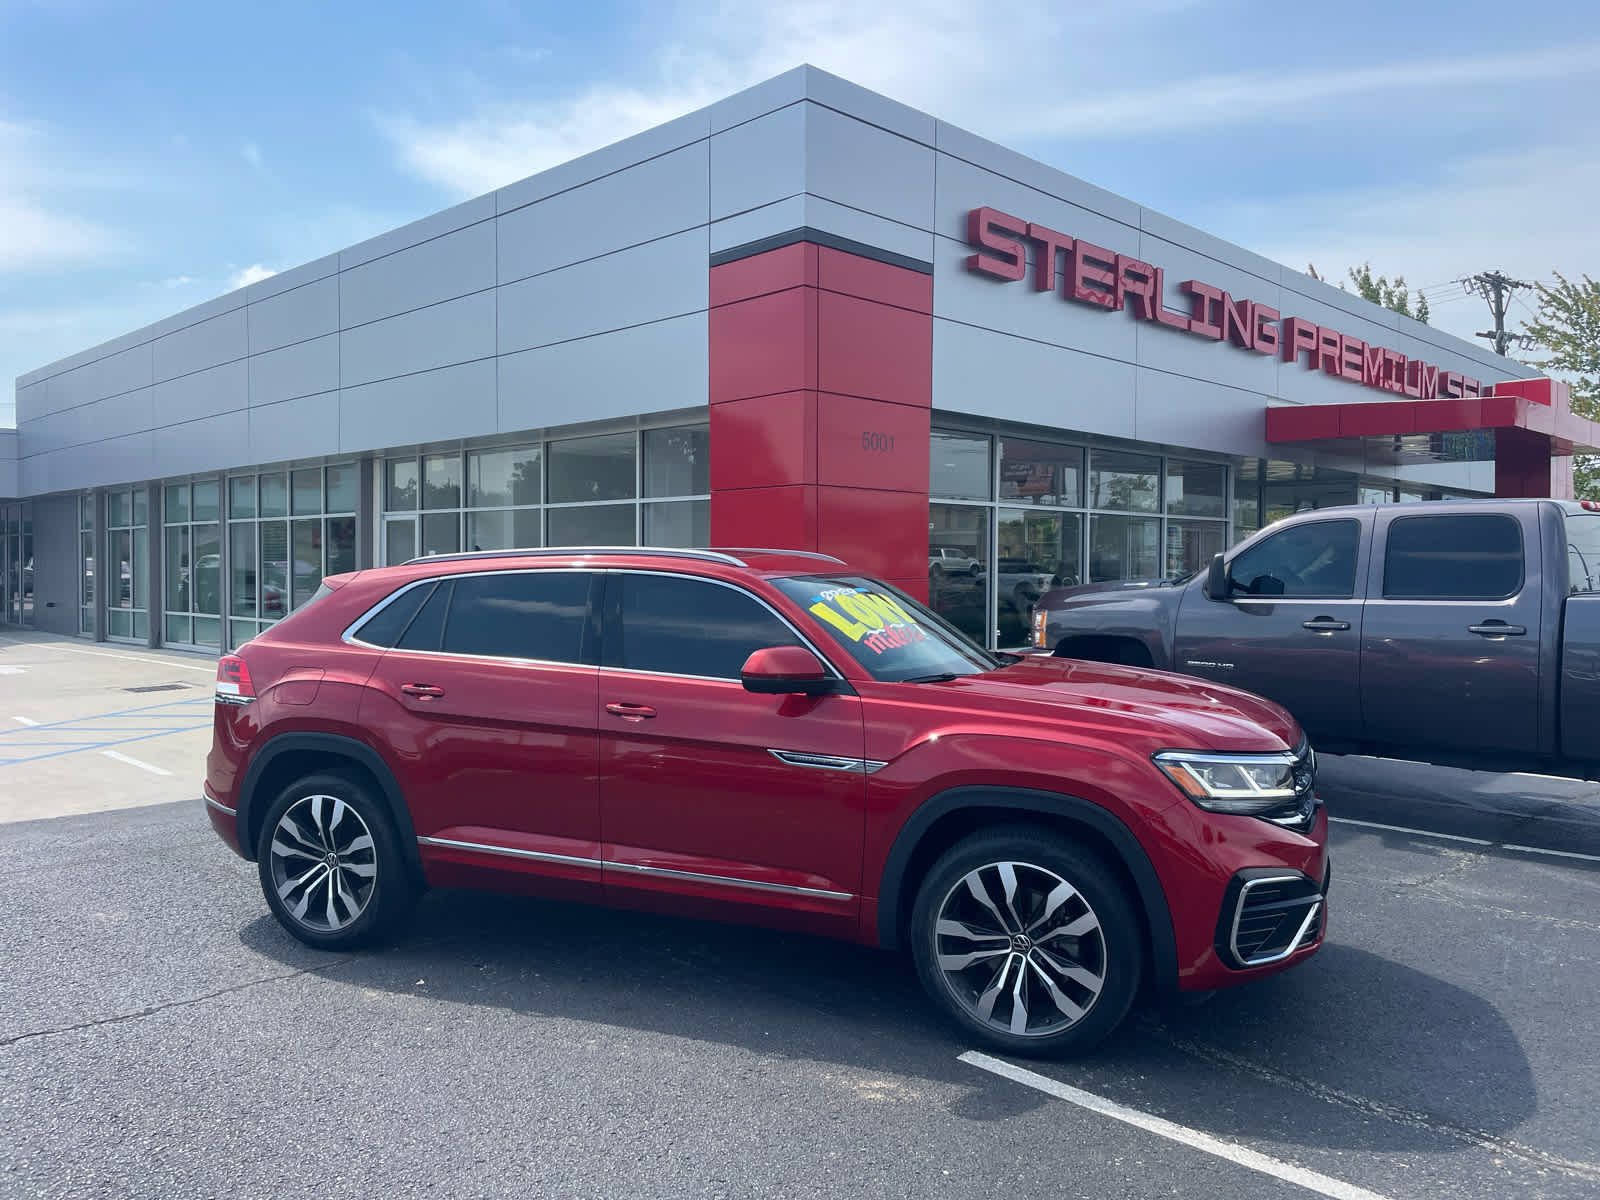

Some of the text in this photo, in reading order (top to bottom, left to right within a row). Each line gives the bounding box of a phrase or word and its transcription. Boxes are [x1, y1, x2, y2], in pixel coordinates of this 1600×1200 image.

[967, 206, 1280, 355] STERLING
[1284, 317, 1439, 400] PREMIUM
[861, 431, 896, 453] 5001
[808, 592, 918, 642] LOW
